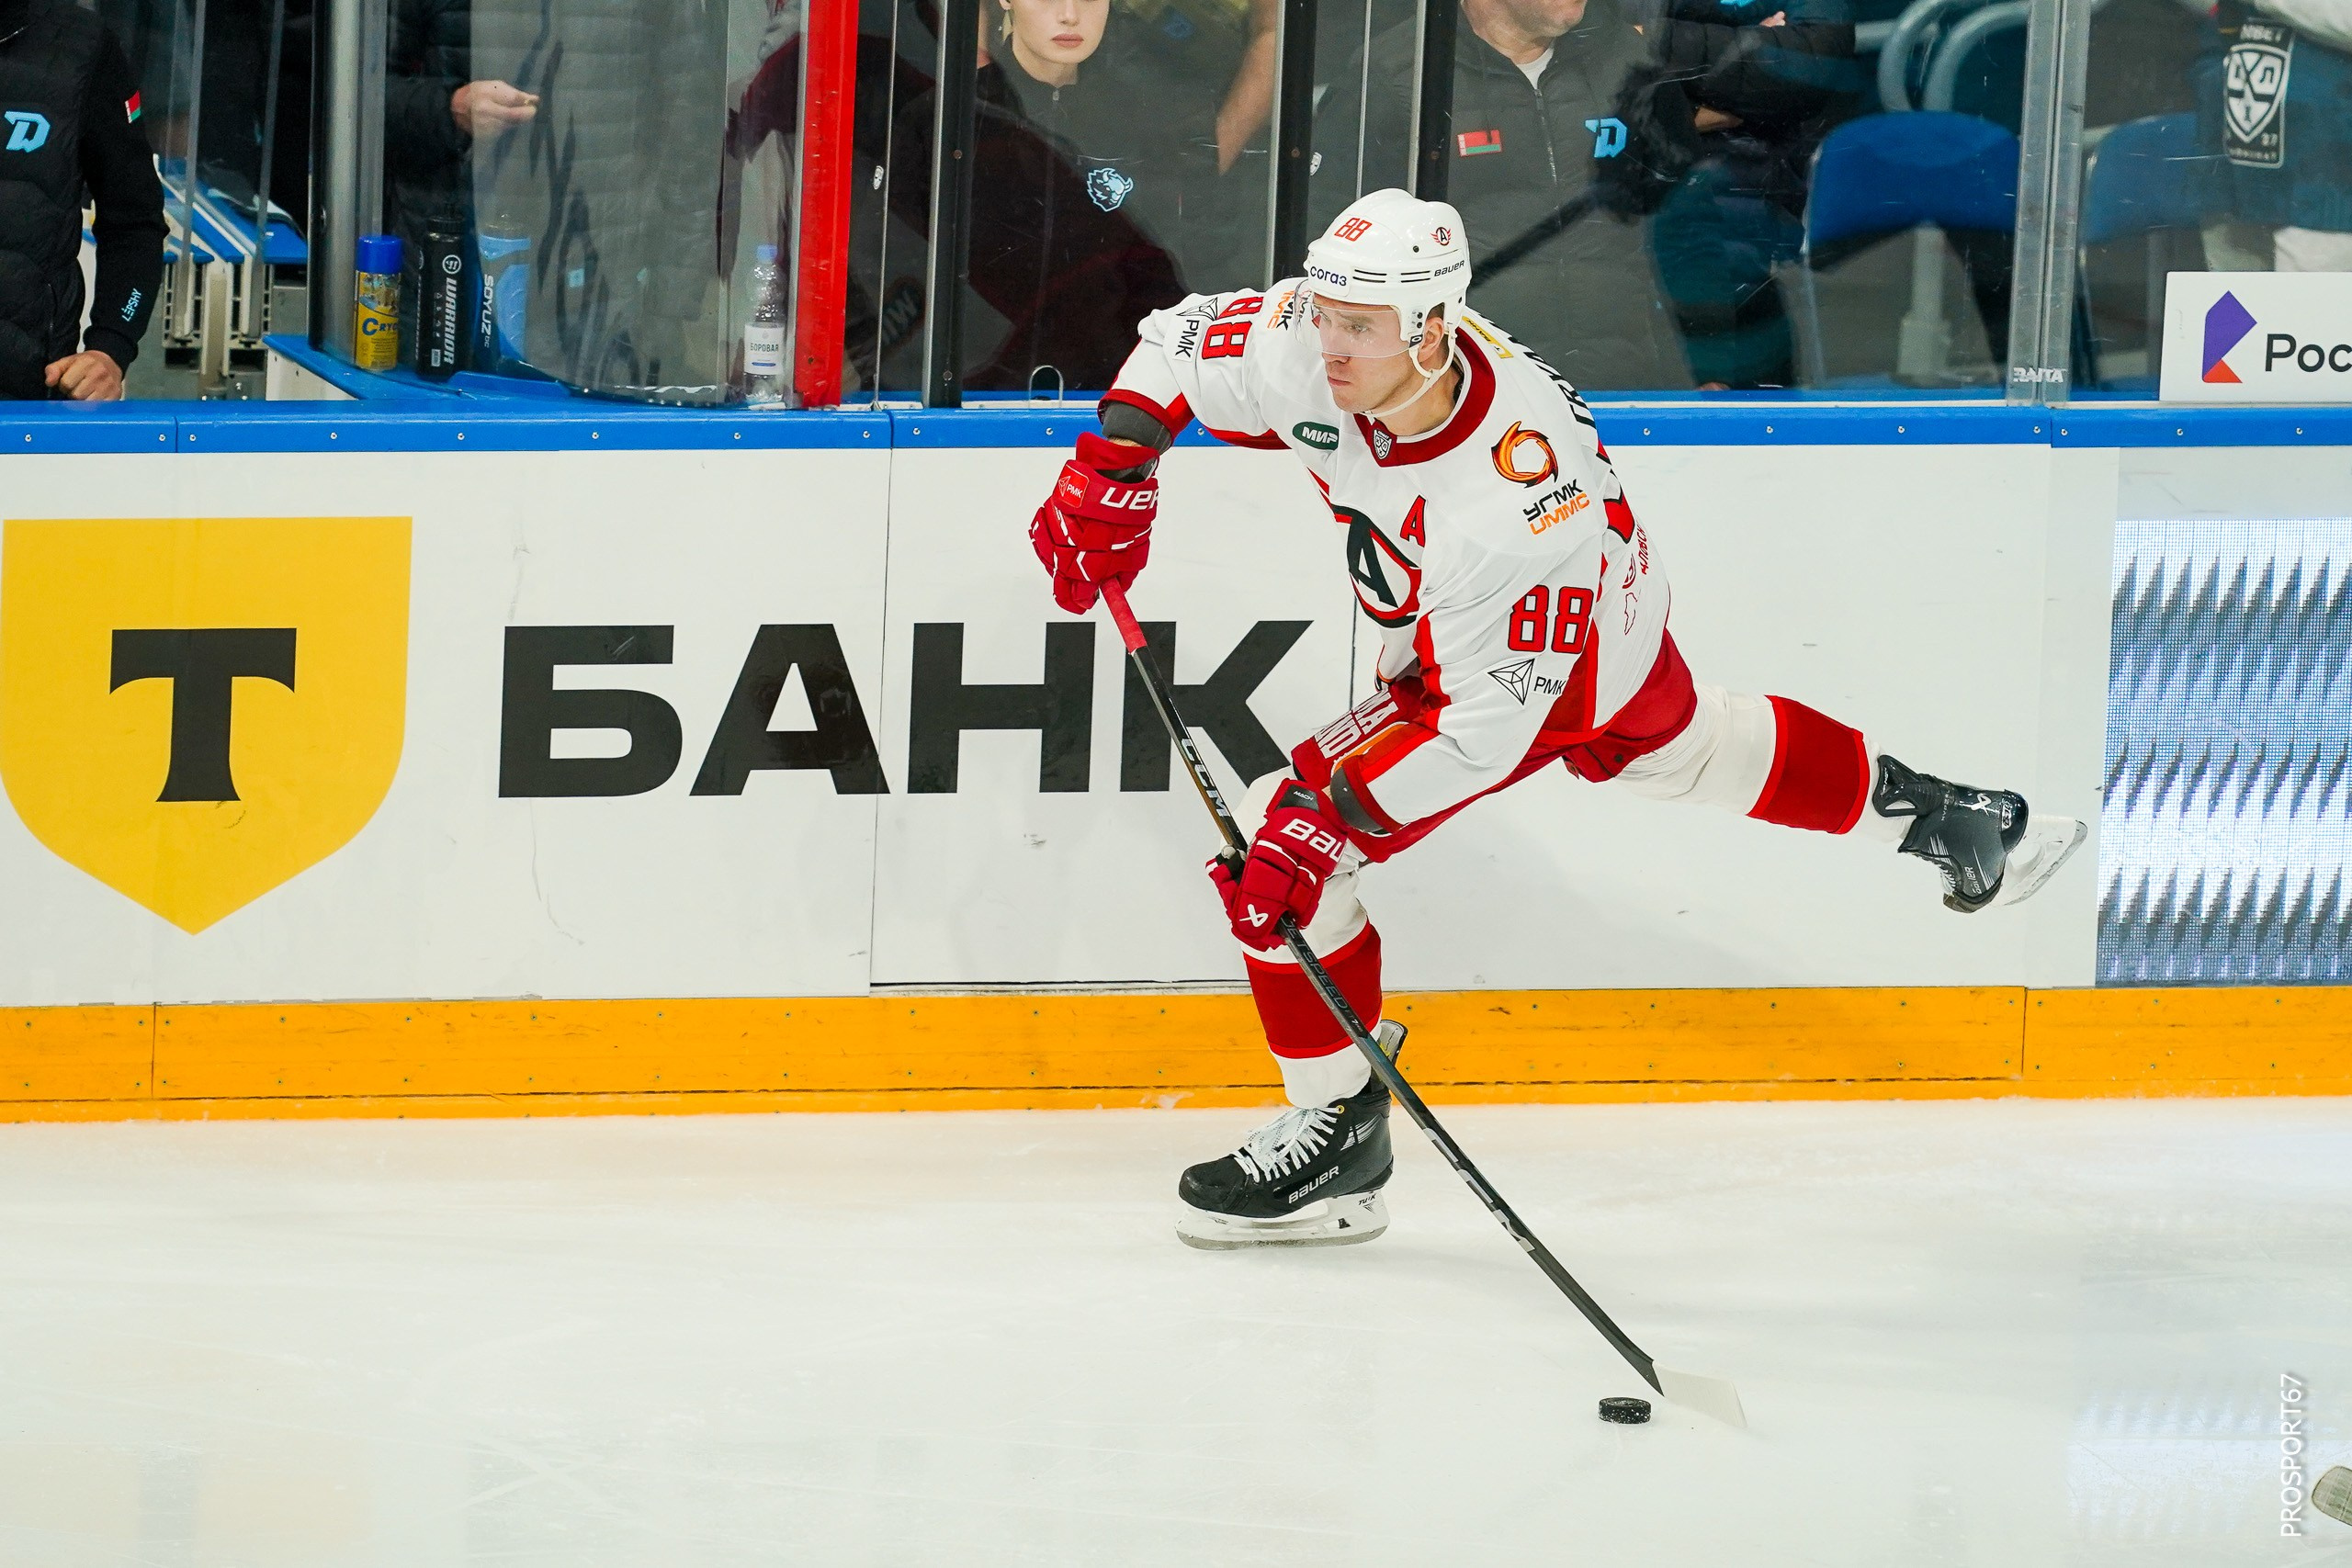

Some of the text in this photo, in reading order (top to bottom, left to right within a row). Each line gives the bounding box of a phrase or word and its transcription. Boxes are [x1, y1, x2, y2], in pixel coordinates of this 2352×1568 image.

[1334, 218, 1373, 243] 88
[444, 276, 458, 365] WARRIOR
[481, 274, 494, 337] SOYUZ
[750, 343, 779, 352] БОРОВАЯ
[1201, 296, 1264, 360] 88
[2265, 333, 2352, 373] Рос
[1067, 484, 1084, 499] РМК
[1522, 479, 1584, 523] УГМК
[1530, 492, 1591, 536] UMMC
[1508, 584, 1595, 654] 88
[109, 620, 1314, 802] Т БАНК
[1181, 738, 1231, 817] CCM
[1288, 1165, 1340, 1204] BAUER
